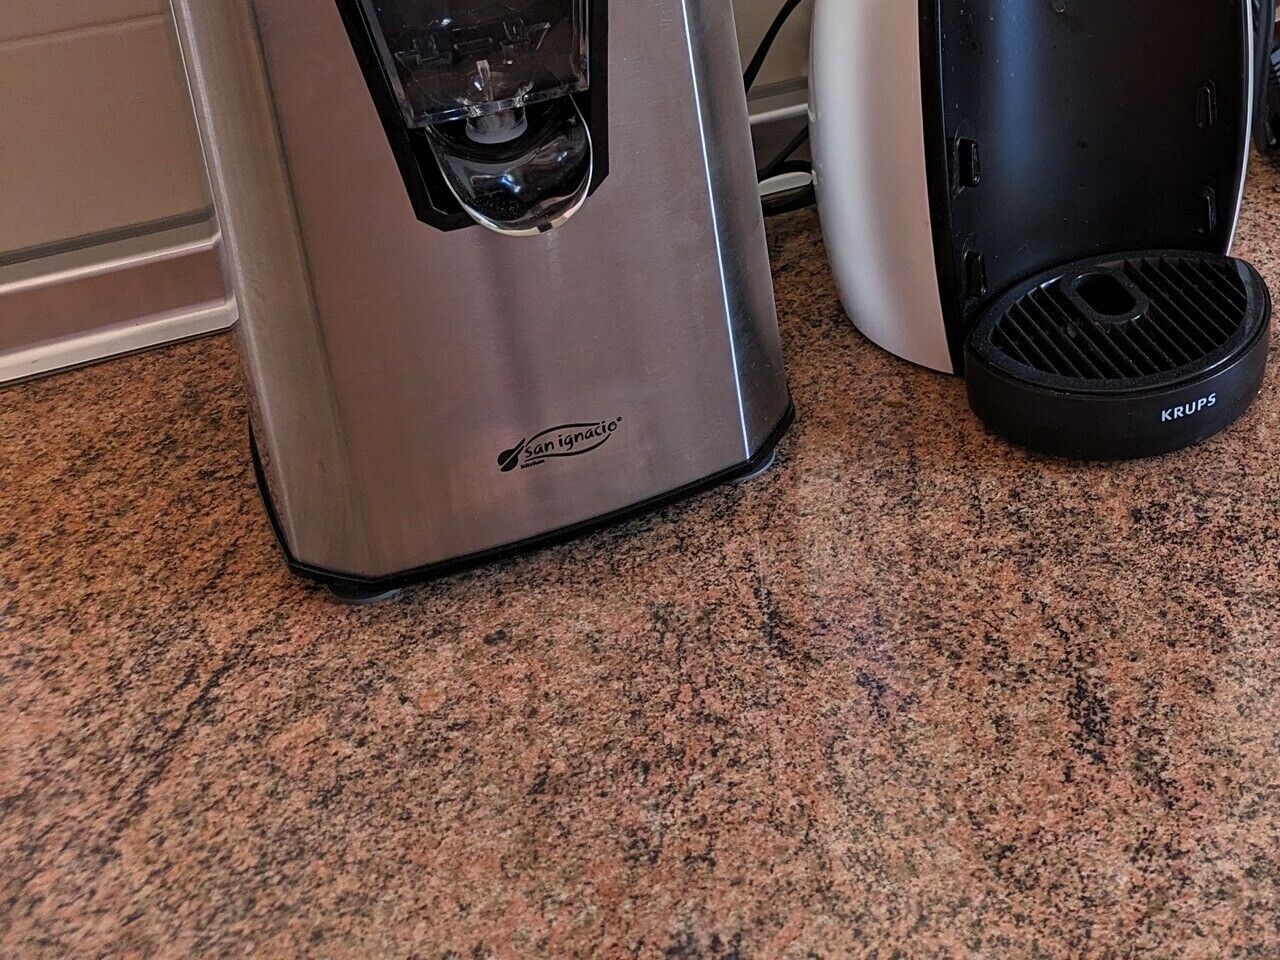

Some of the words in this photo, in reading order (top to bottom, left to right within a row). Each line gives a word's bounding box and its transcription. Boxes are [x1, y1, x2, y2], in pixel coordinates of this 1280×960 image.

[1161, 393, 1216, 422] KRUPS
[525, 441, 555, 458] san
[558, 421, 618, 451] ignacio
